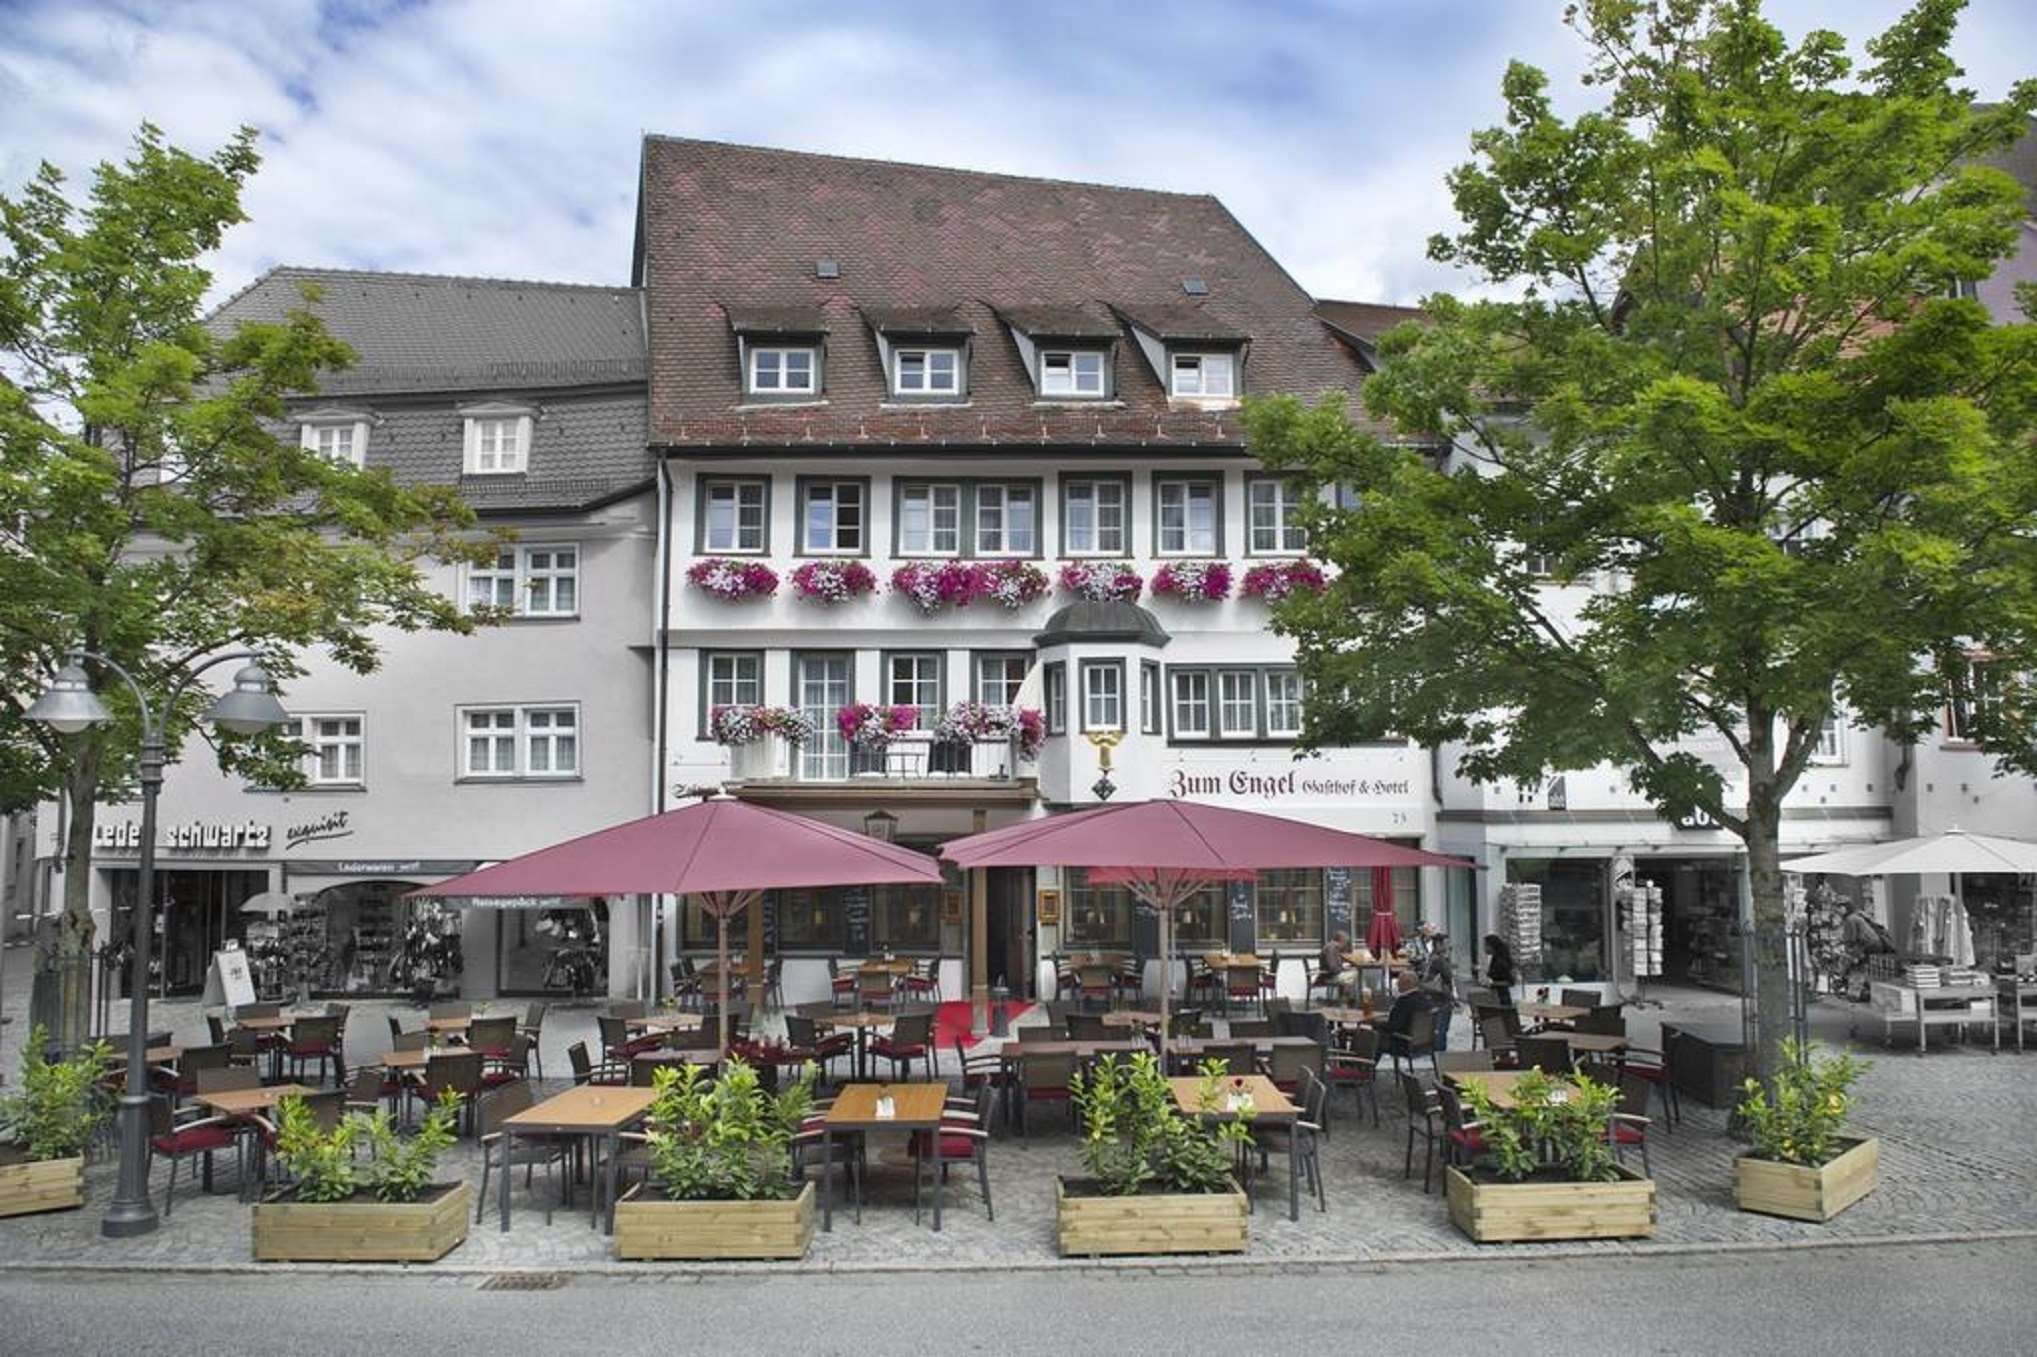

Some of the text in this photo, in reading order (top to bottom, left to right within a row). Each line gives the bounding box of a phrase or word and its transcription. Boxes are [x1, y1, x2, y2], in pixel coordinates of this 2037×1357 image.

[1170, 769, 1221, 797] Zum
[1228, 769, 1296, 799] Engel
[1358, 780, 1370, 795] &
[1372, 779, 1409, 798] Hotel
[93, 821, 142, 848] Lede
